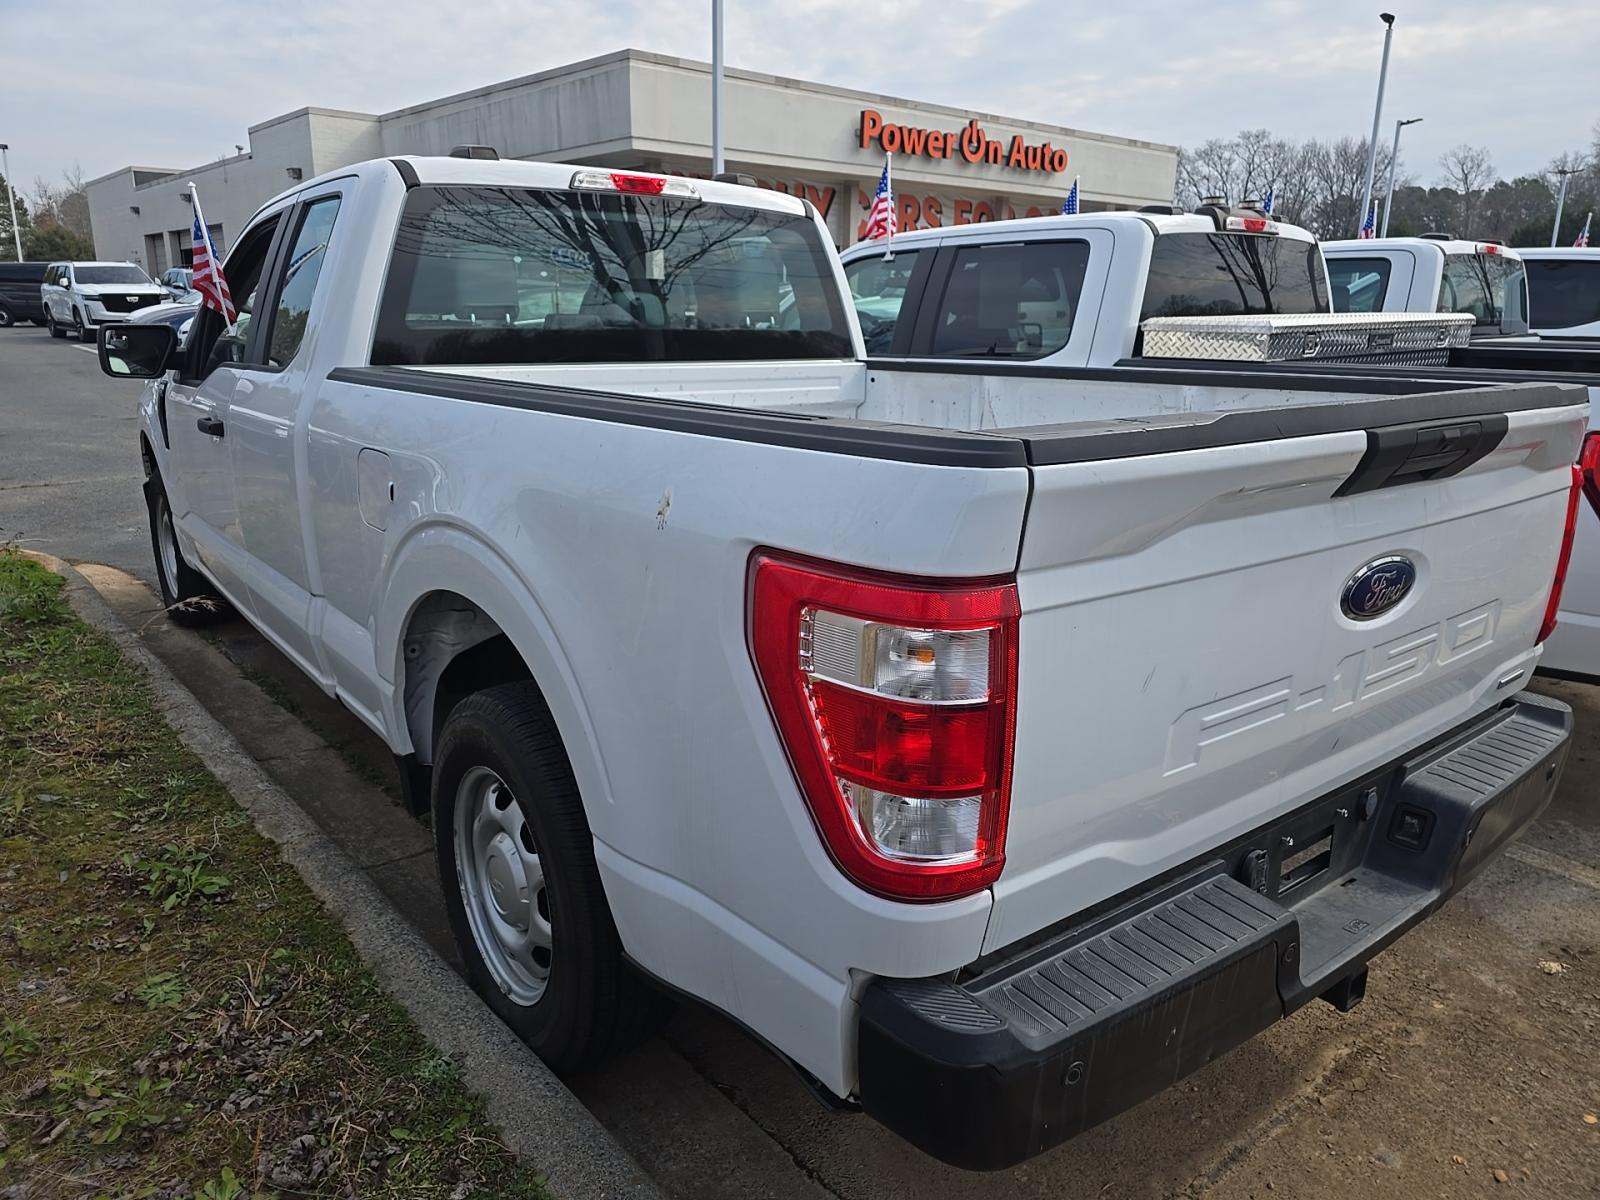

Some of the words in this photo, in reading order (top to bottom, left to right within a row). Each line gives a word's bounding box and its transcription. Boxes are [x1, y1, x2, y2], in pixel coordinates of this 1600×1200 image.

[859, 109, 957, 160] Power
[959, 119, 1002, 165] On
[1006, 135, 1069, 173] Auto
[1364, 570, 1408, 610] Ford
[1163, 598, 1500, 777] F-150
